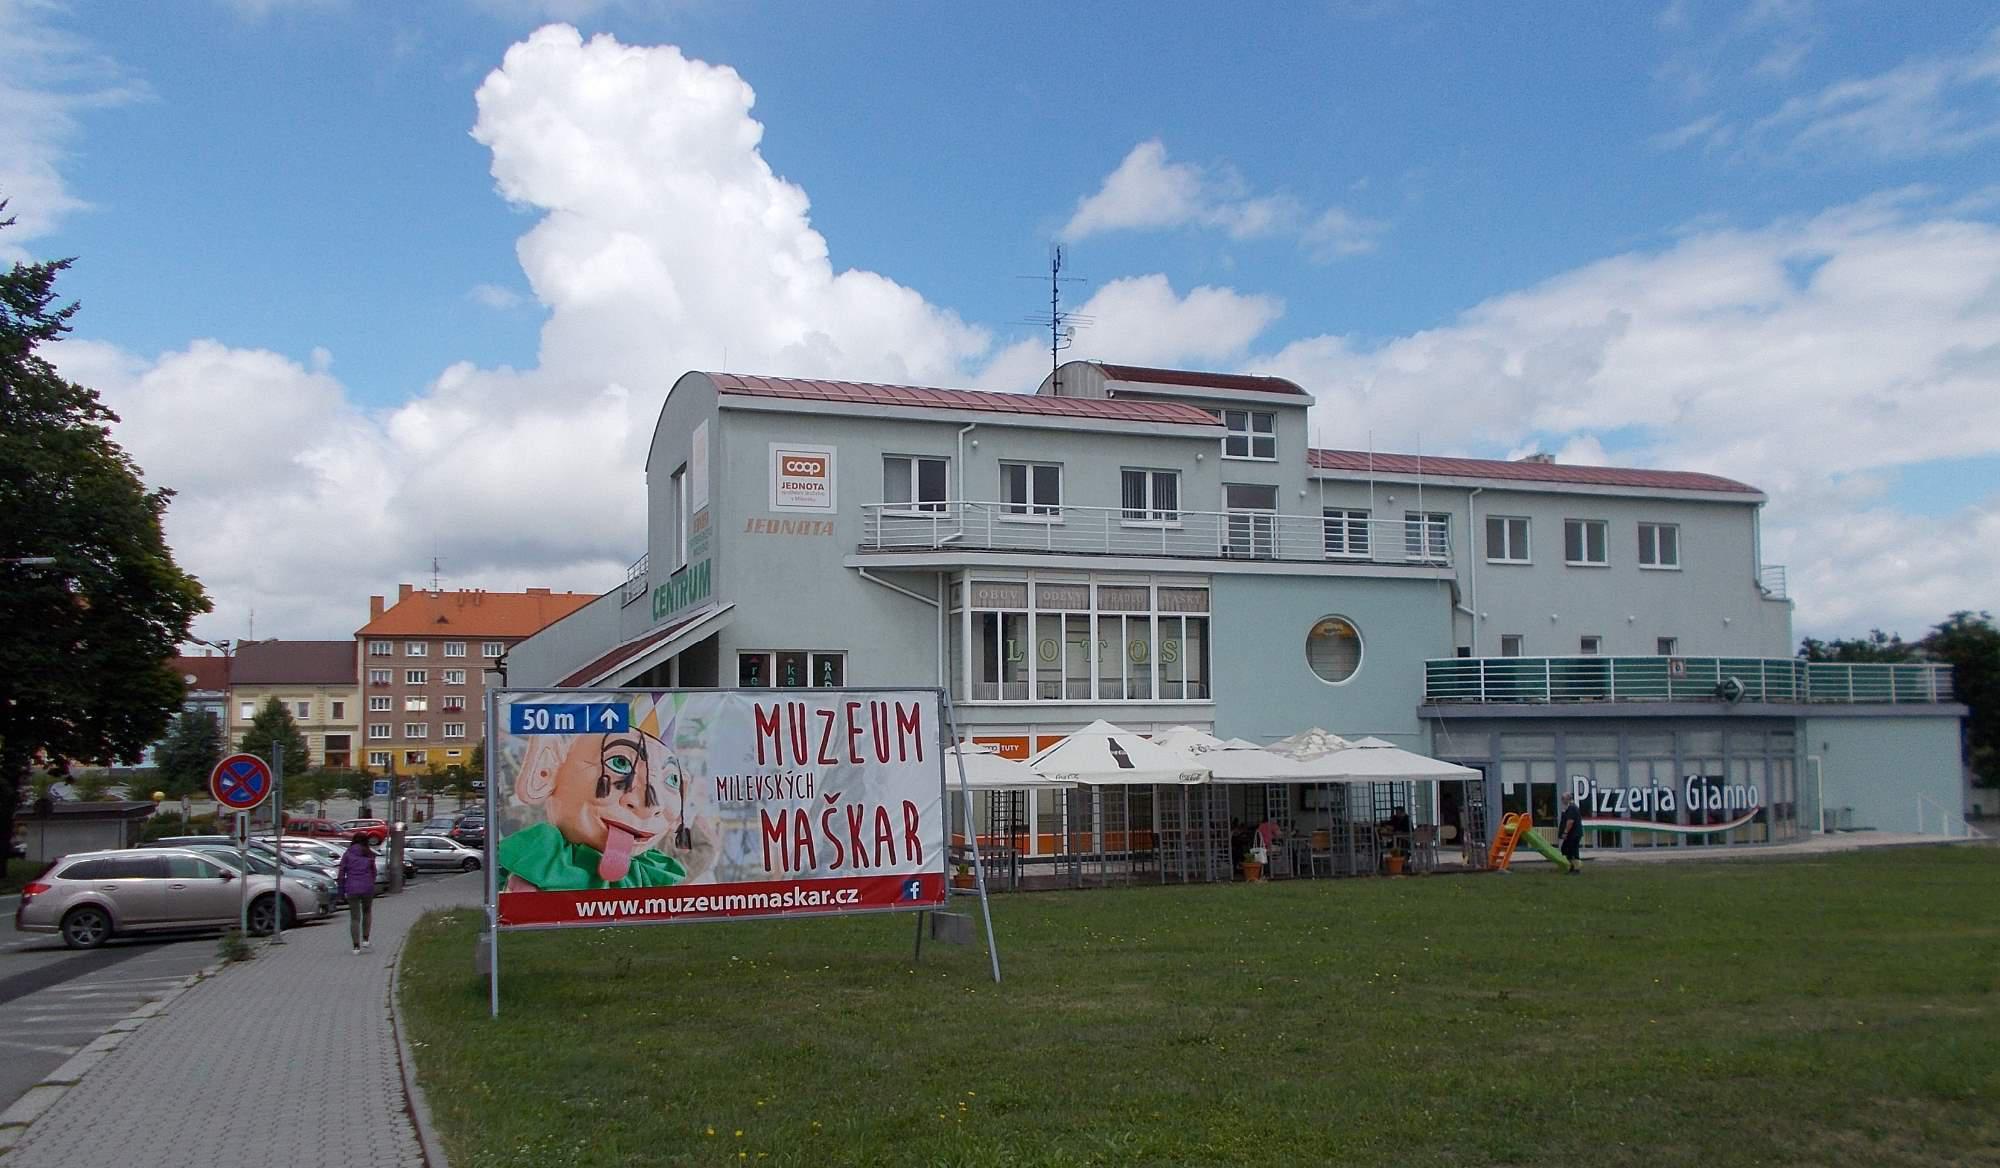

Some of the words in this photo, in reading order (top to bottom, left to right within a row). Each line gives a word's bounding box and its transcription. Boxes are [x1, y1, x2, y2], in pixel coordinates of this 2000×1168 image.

[787, 461, 820, 475] coop
[782, 482, 825, 490] JEDNOTA
[744, 519, 834, 536] JEDNOTA
[652, 558, 711, 621] CENTRUM
[978, 589, 1018, 600] OBUV
[1006, 638, 1178, 663] LOTOS
[523, 708, 549, 731] 50
[554, 713, 574, 730] m
[754, 701, 923, 766] MUZEUM
[716, 772, 814, 802] MILEVSKÝCH
[1572, 774, 1676, 813] Pizzeria
[1686, 774, 1758, 811] Gianno
[760, 792, 923, 873] MAŠKAR
[575, 886, 858, 917] www.muzeummaskar.cz
